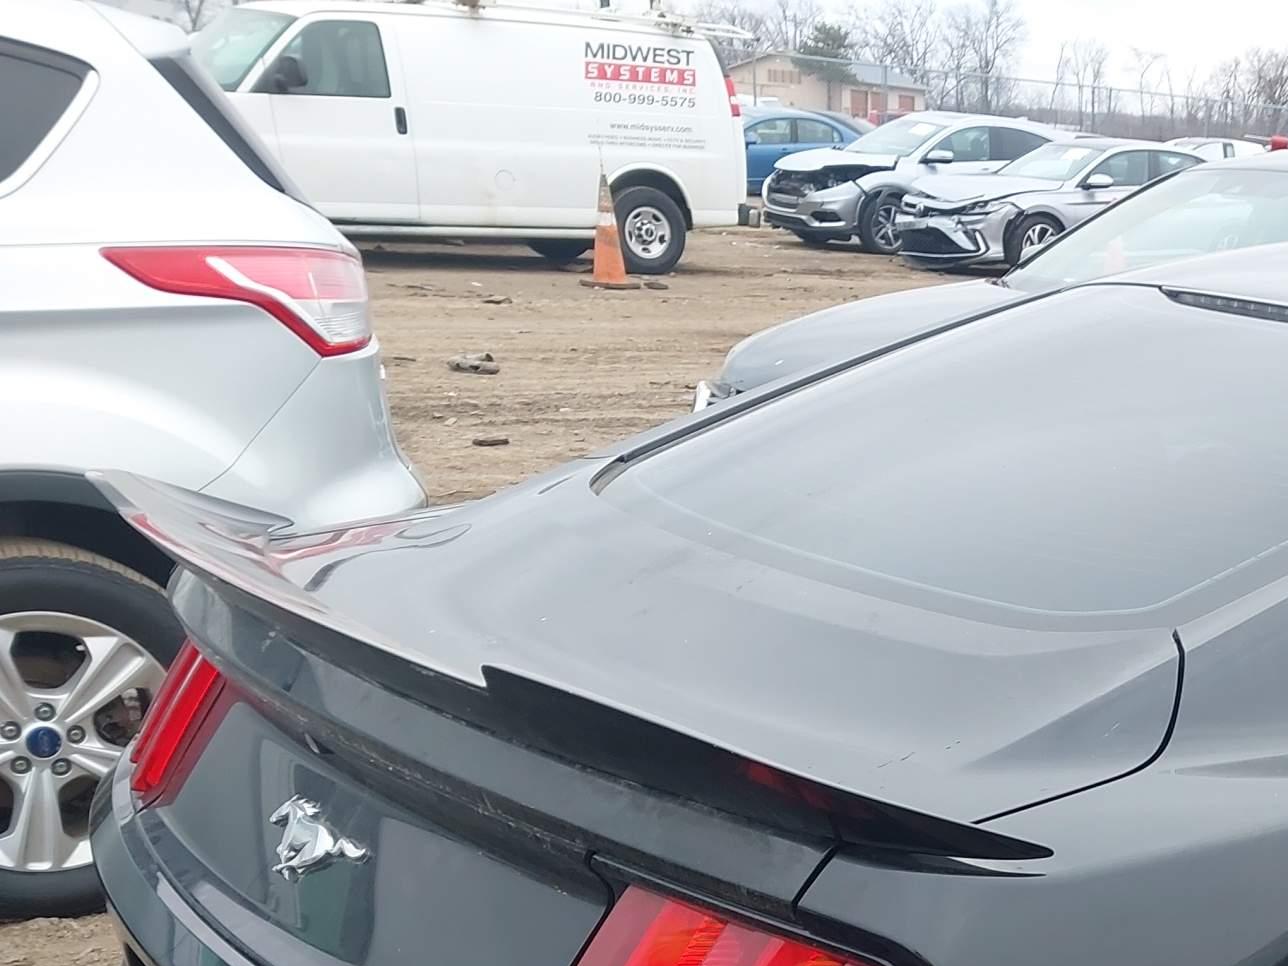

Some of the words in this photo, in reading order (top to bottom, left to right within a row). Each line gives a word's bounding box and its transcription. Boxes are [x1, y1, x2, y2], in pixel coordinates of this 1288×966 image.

[584, 41, 695, 67] MIDWEST
[586, 62, 695, 85] SYSTEMS
[593, 91, 697, 109] 800-999-5575
